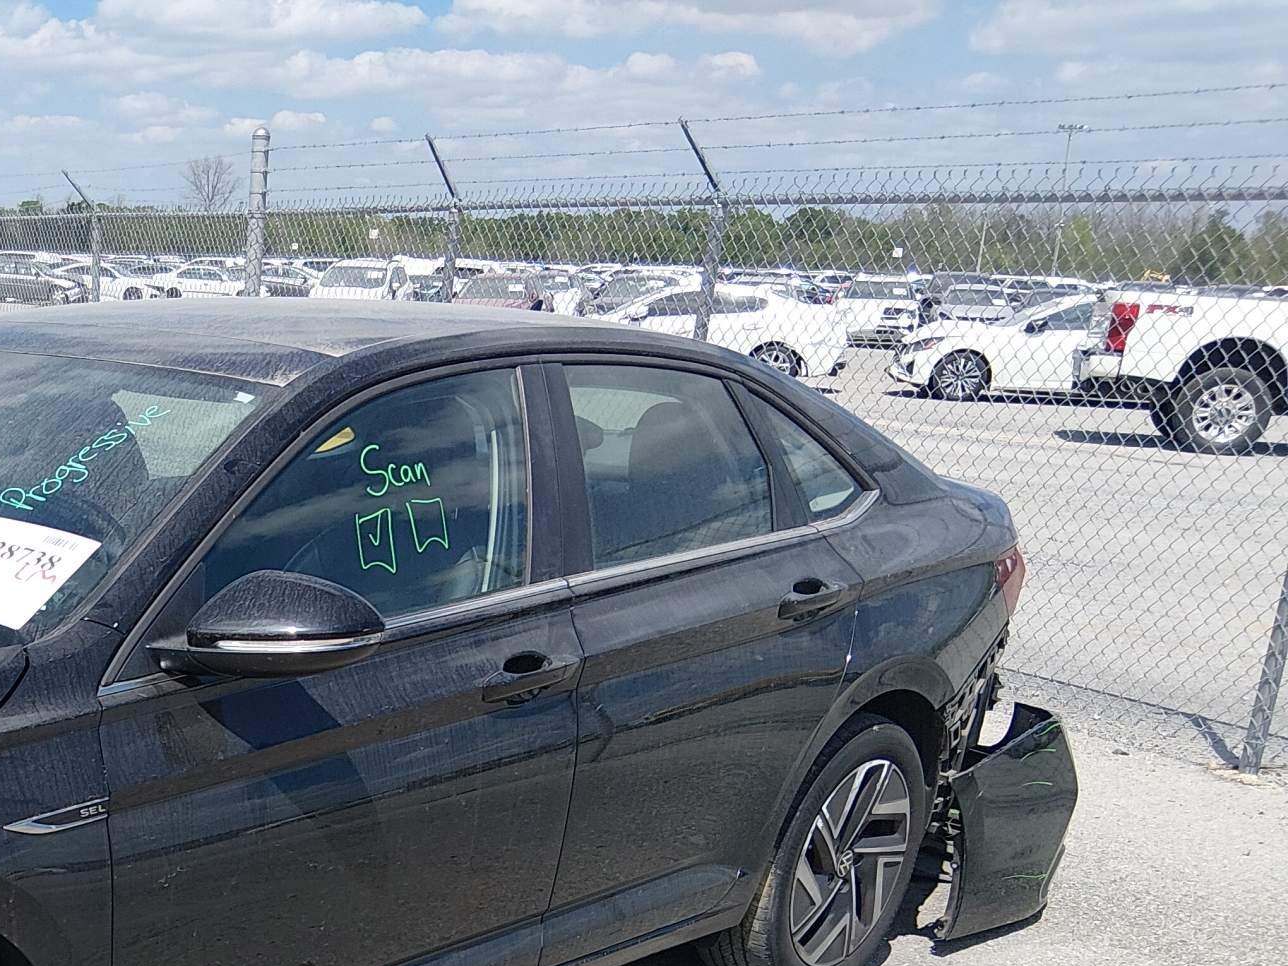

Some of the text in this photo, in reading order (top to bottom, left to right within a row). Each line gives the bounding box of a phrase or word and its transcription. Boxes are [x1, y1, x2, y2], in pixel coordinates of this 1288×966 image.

[0, 403, 172, 511] Progressive
[360, 444, 431, 497] Scan
[79, 804, 106, 818] SEL
